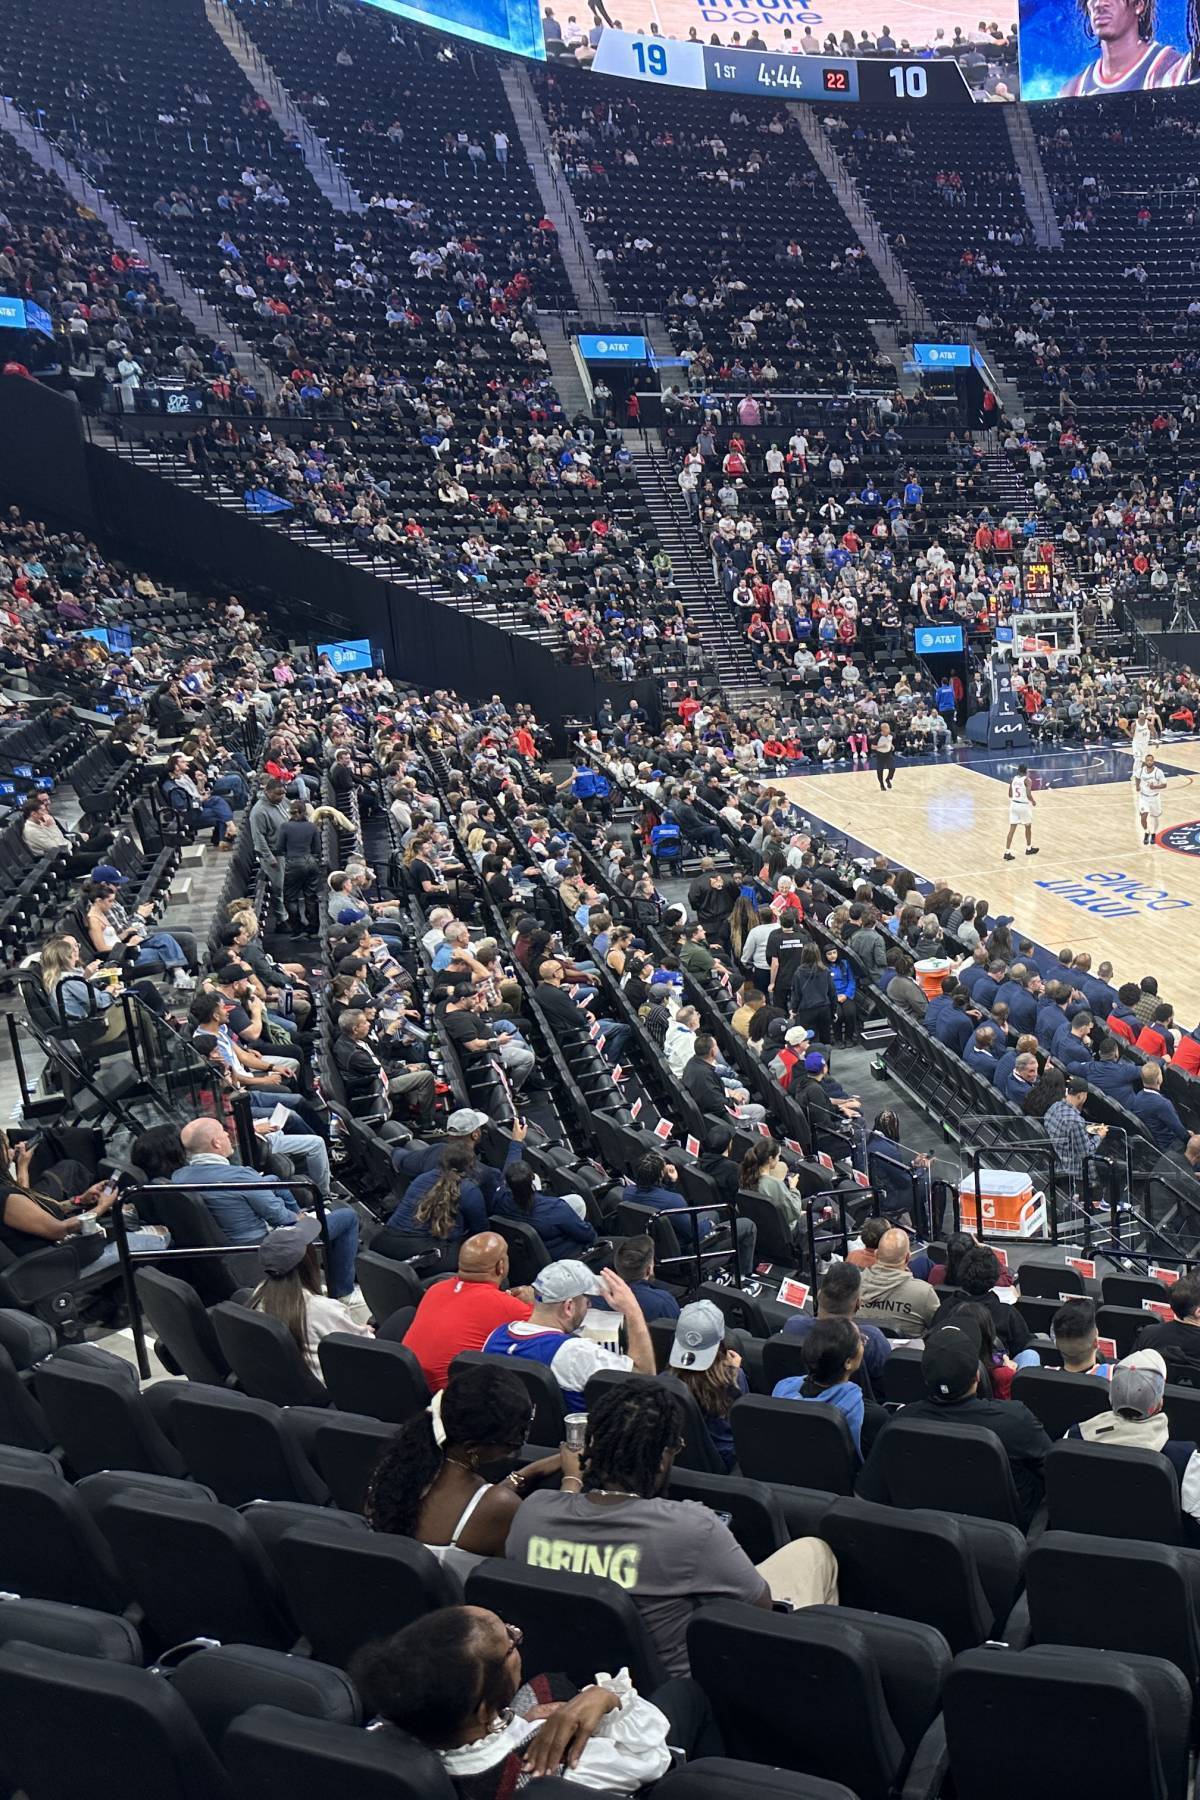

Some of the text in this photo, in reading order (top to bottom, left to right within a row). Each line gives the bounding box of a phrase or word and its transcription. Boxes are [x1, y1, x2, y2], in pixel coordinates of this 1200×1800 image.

[632, 42, 668, 76] 19
[758, 62, 803, 89] 4:44
[827, 73, 846, 89] 22
[889, 66, 928, 98] 10
[609, 343, 629, 351] AT&T
[939, 351, 956, 359] AT&T
[935, 634, 956, 645] AT&T
[864, 1300, 912, 1314] SAINTS
